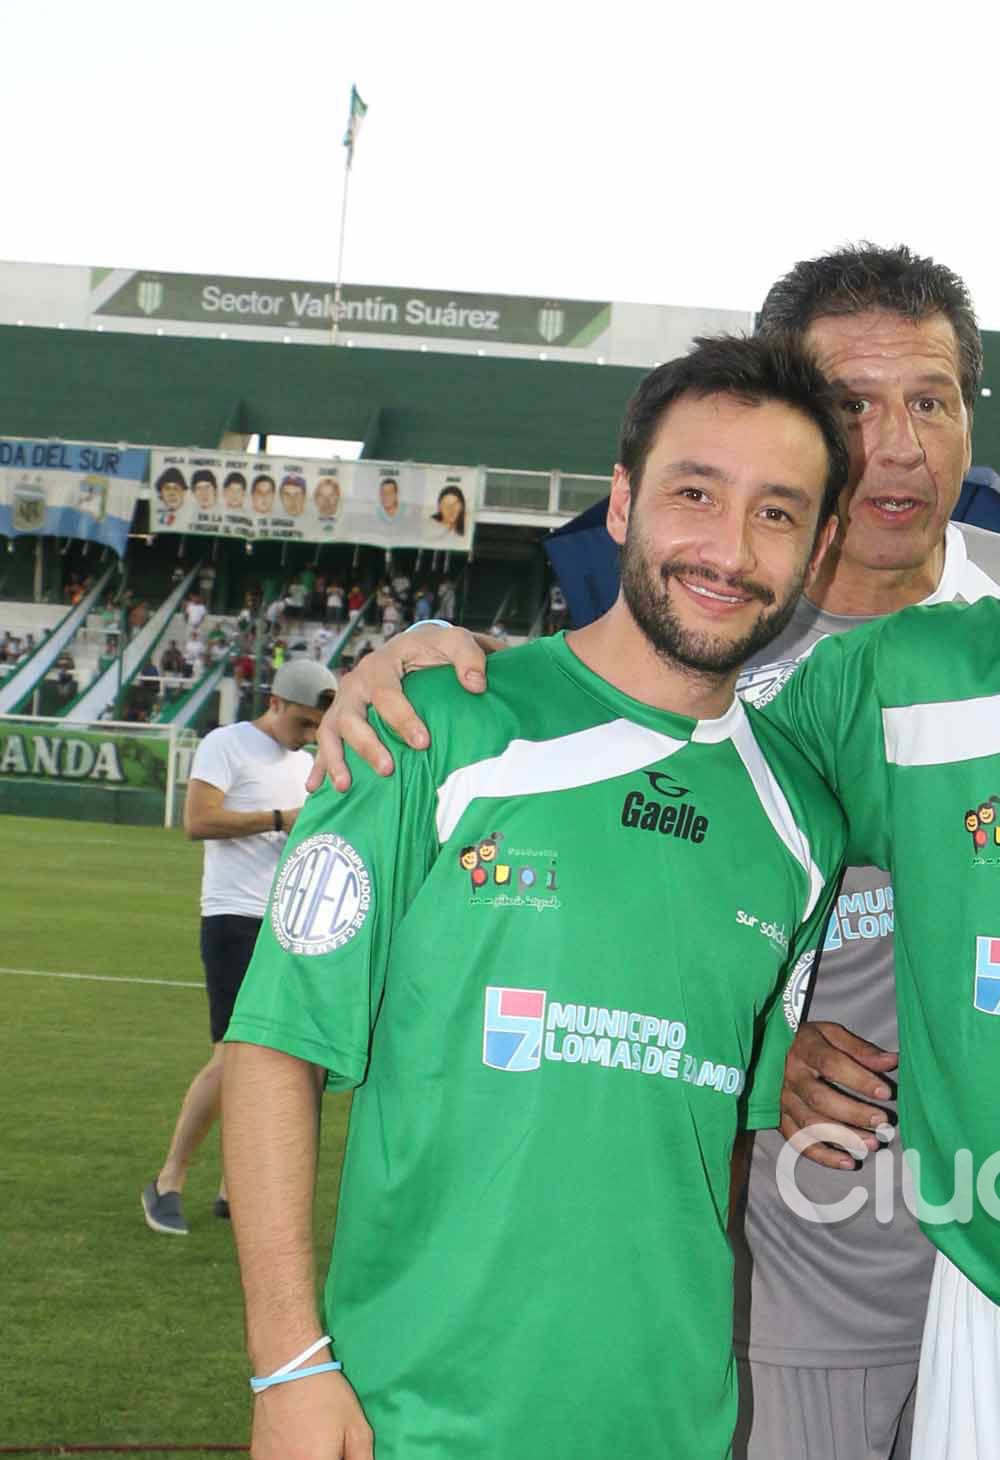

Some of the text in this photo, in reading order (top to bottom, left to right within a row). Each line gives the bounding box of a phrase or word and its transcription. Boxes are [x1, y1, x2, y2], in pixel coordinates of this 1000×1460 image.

[201, 285, 500, 330] Sector Valentín Suárez
[31, 444, 73, 469] DEL
[79, 448, 120, 474] SUR
[621, 791, 709, 844] Gaelle
[471, 861, 558, 896] pupi
[735, 910, 759, 927] sur
[544, 1031, 641, 1072] LOMAS
[641, 1046, 682, 1079] DE
